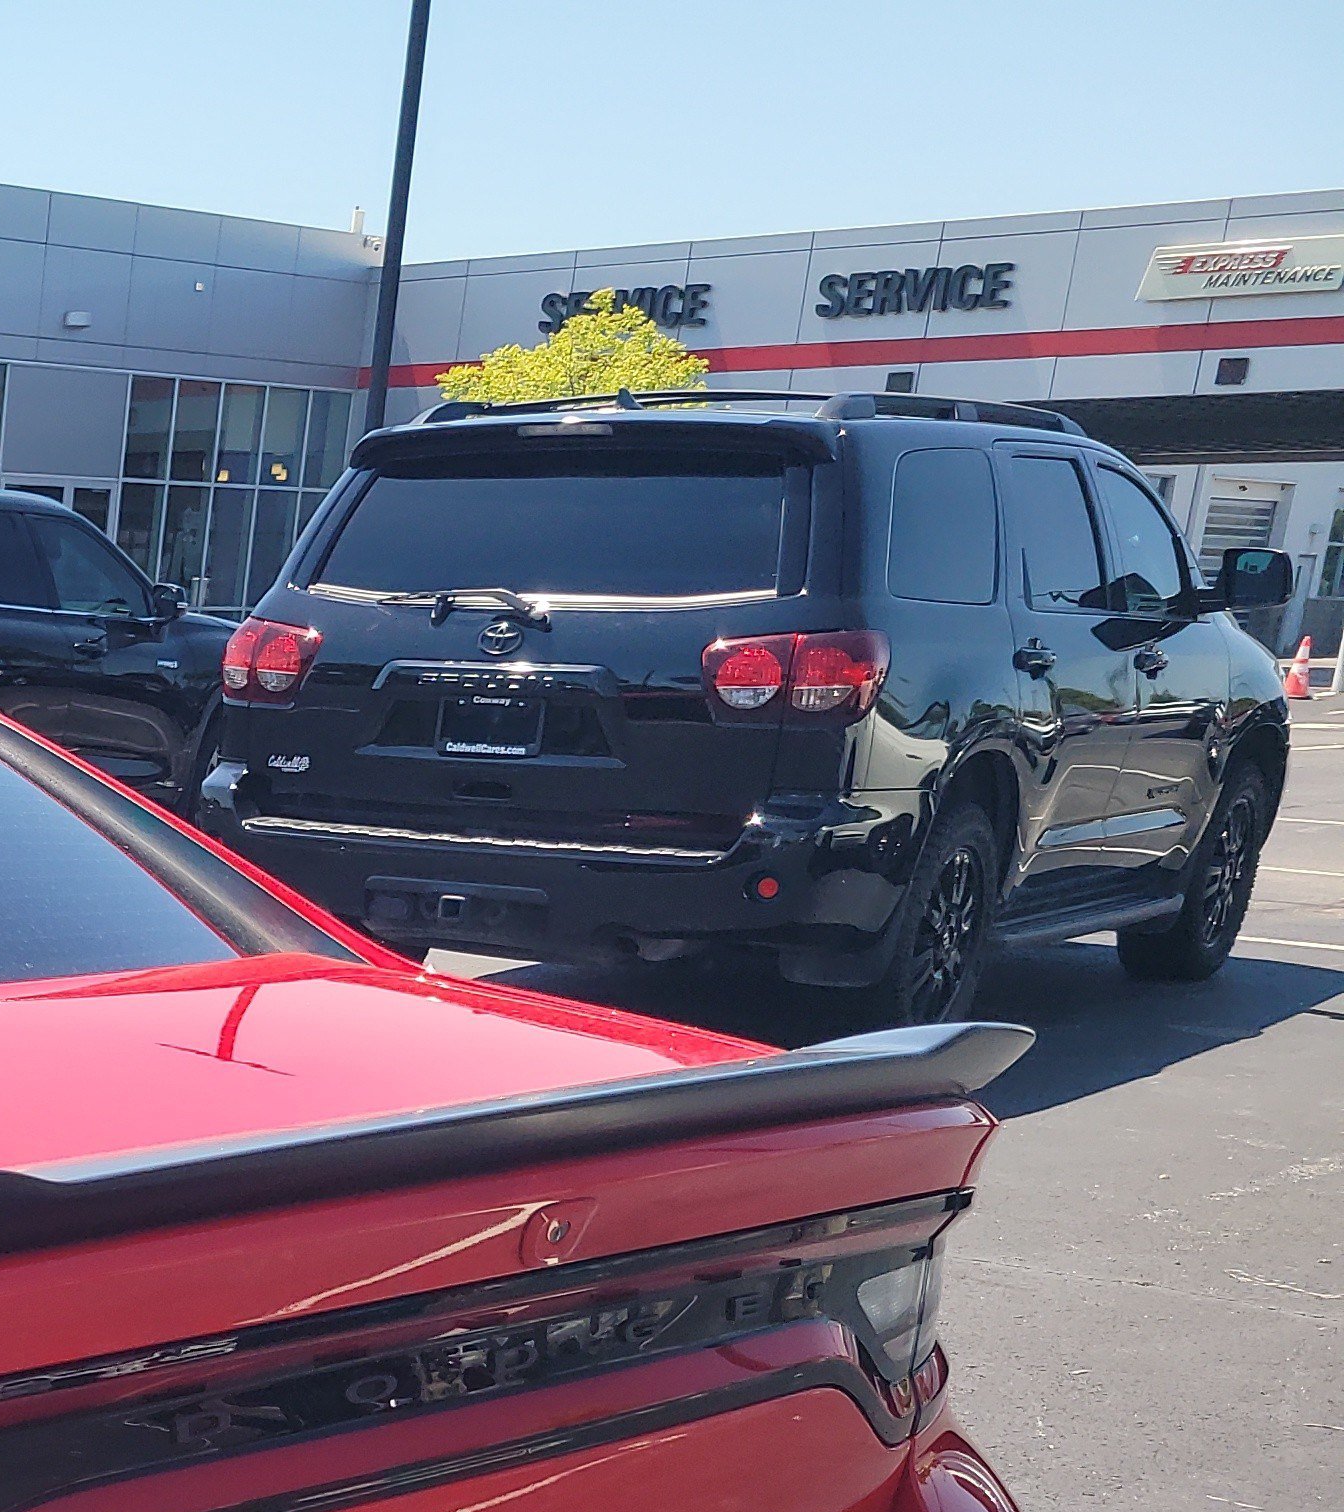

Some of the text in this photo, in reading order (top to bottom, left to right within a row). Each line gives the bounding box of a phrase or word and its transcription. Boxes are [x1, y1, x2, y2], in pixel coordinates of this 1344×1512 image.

[1189, 253, 1280, 274] EXPRESS
[1202, 264, 1341, 290] MAINTENANCE
[816, 262, 1016, 319] SERVICE
[538, 284, 712, 334] SEVICE
[472, 695, 511, 707] Conway
[445, 741, 527, 756] CaldwellCares.com
